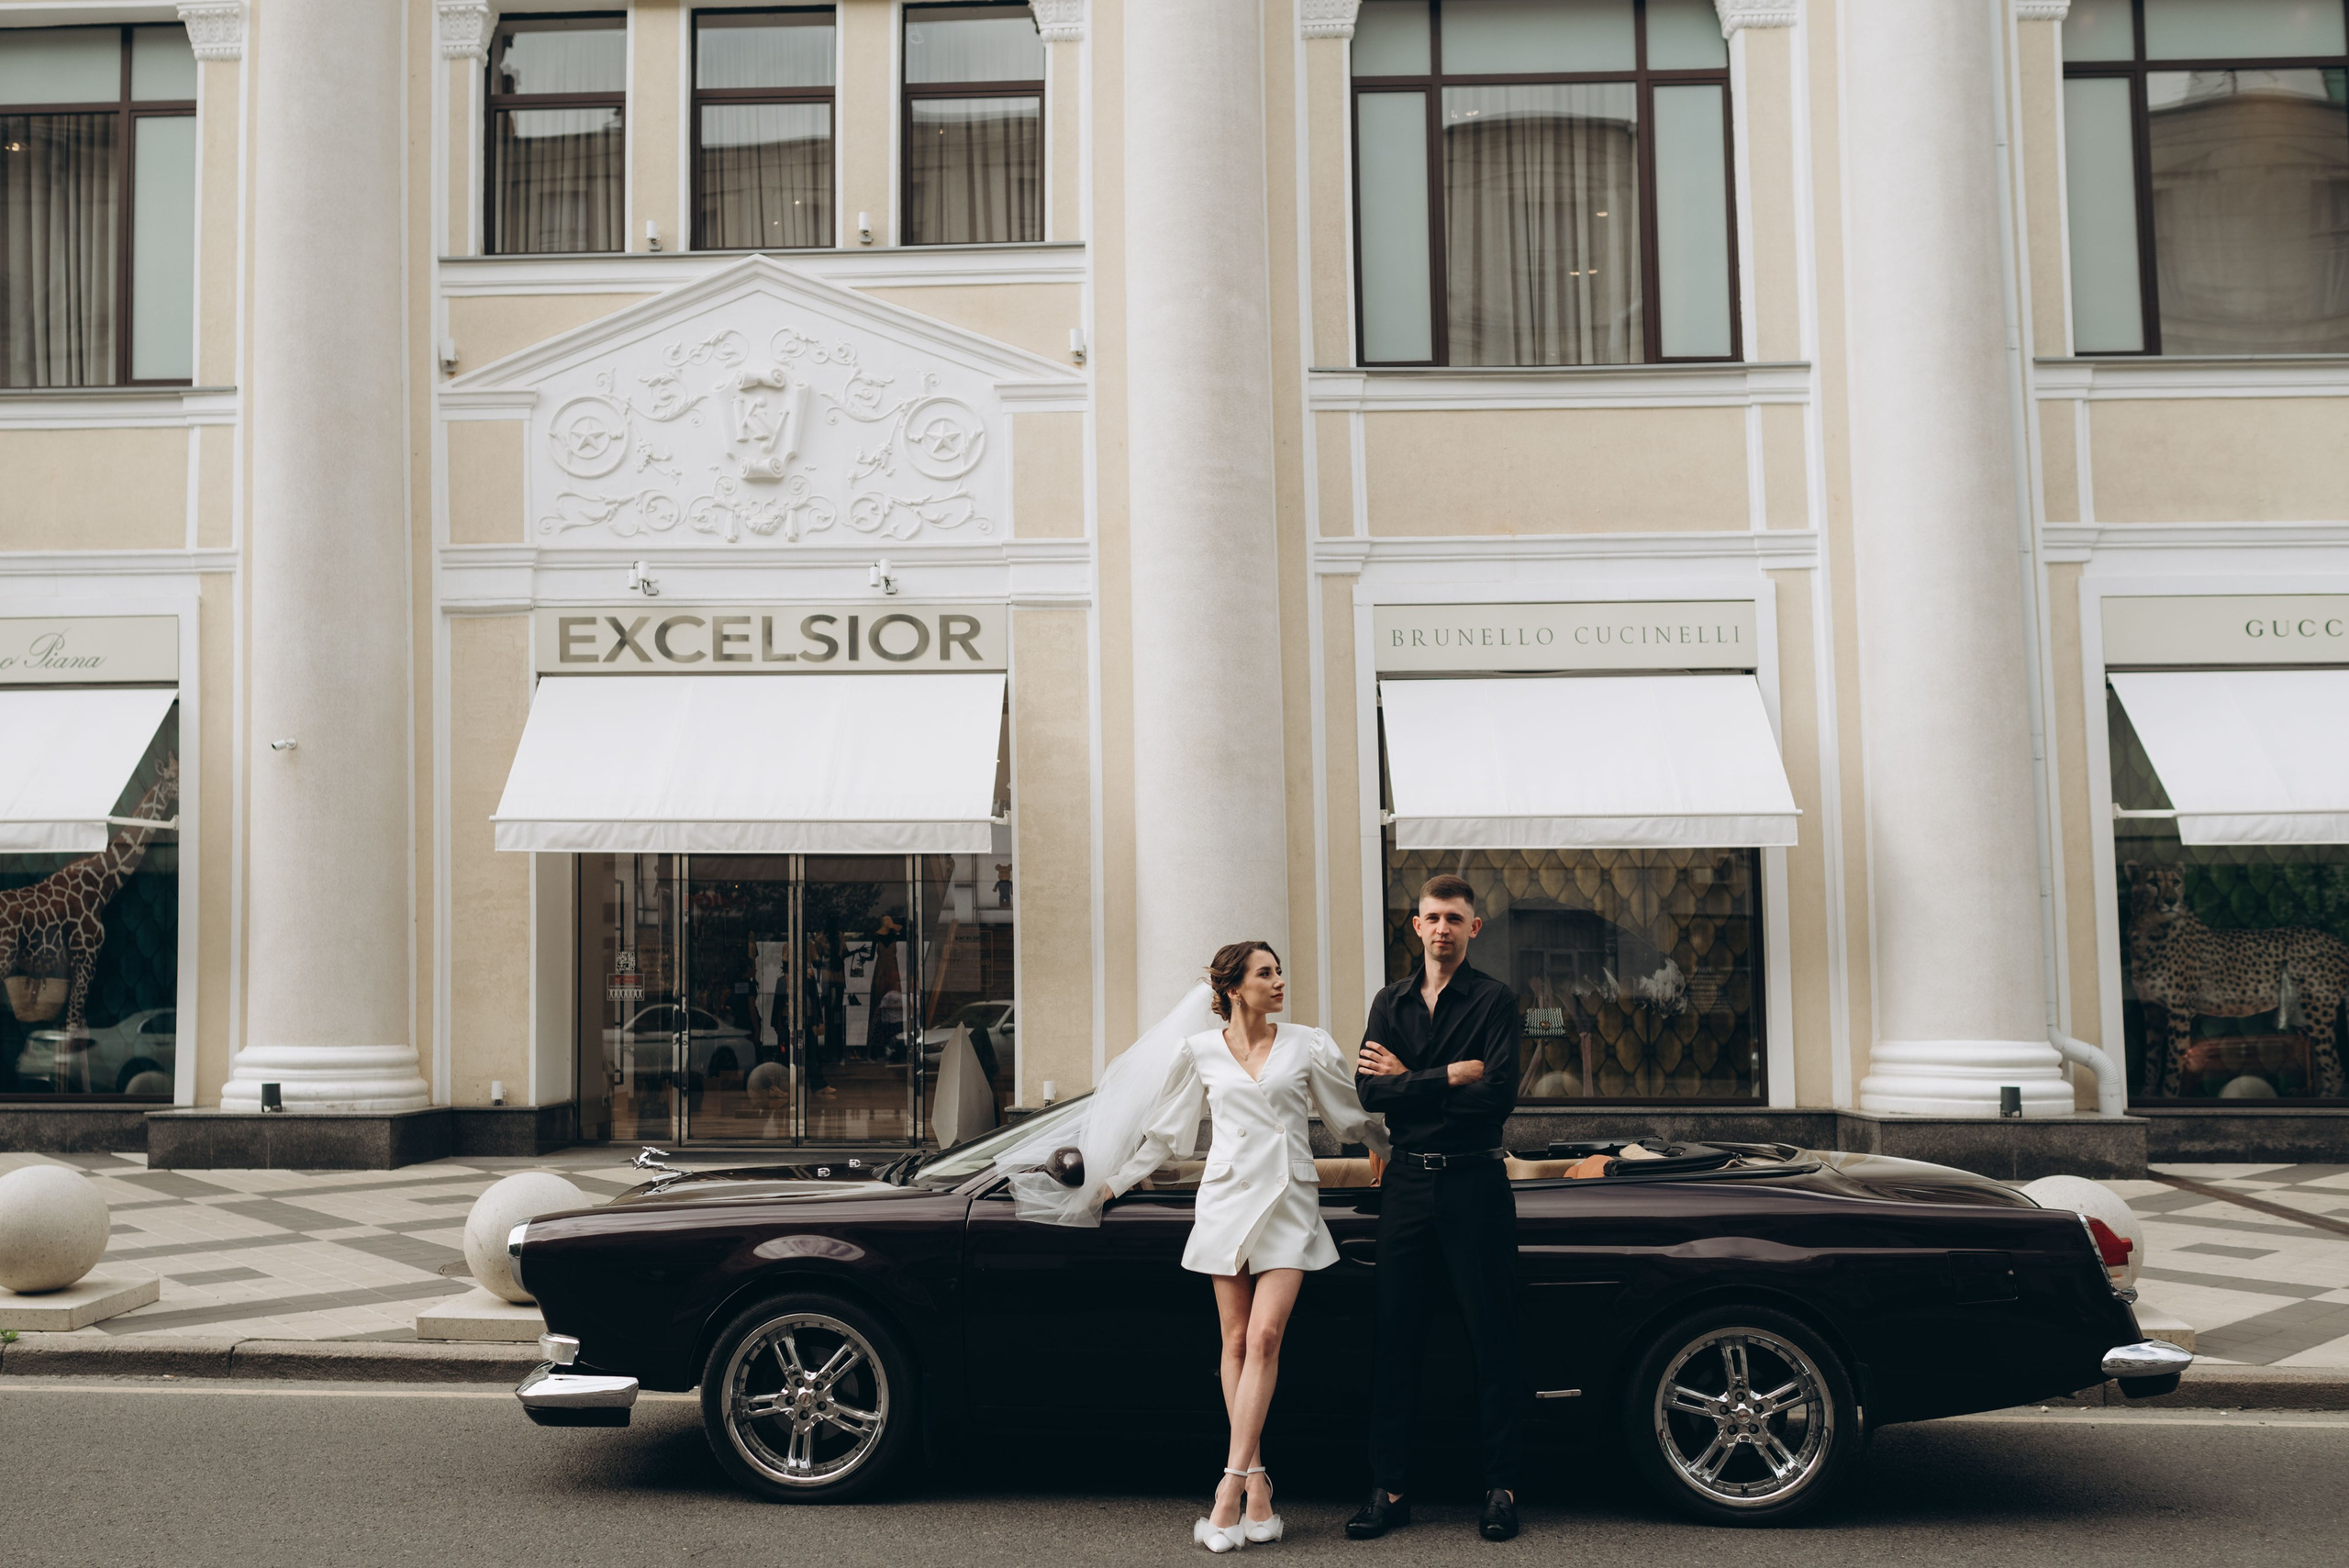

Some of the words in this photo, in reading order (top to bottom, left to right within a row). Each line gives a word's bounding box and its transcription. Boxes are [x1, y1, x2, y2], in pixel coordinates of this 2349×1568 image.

[557, 612, 985, 663] EXCELSIOR
[1390, 626, 1555, 648] BRUNELLO
[1574, 625, 1742, 646] CUCINELLI
[2245, 618, 2344, 638] GUCC
[24, 627, 106, 669] Piana
